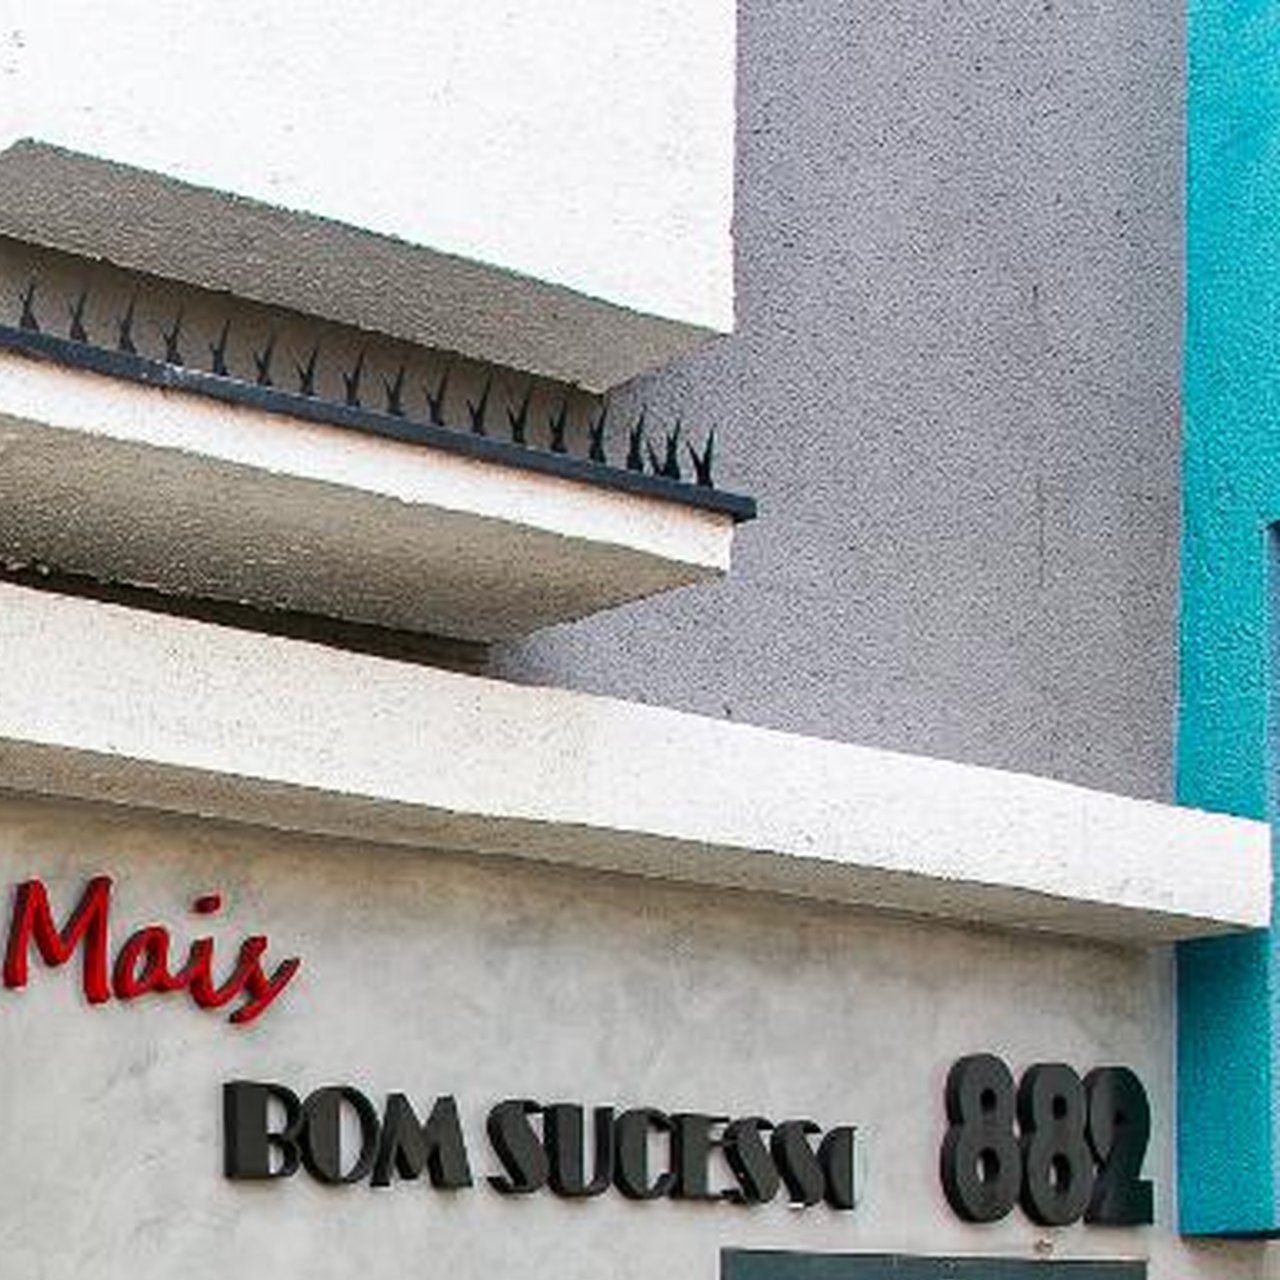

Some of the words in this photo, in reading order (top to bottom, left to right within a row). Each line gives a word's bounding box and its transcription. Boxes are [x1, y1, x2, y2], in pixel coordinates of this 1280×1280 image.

[2, 875, 301, 1025] Mais
[223, 1080, 473, 1187] BOM
[941, 1053, 1154, 1226] 882
